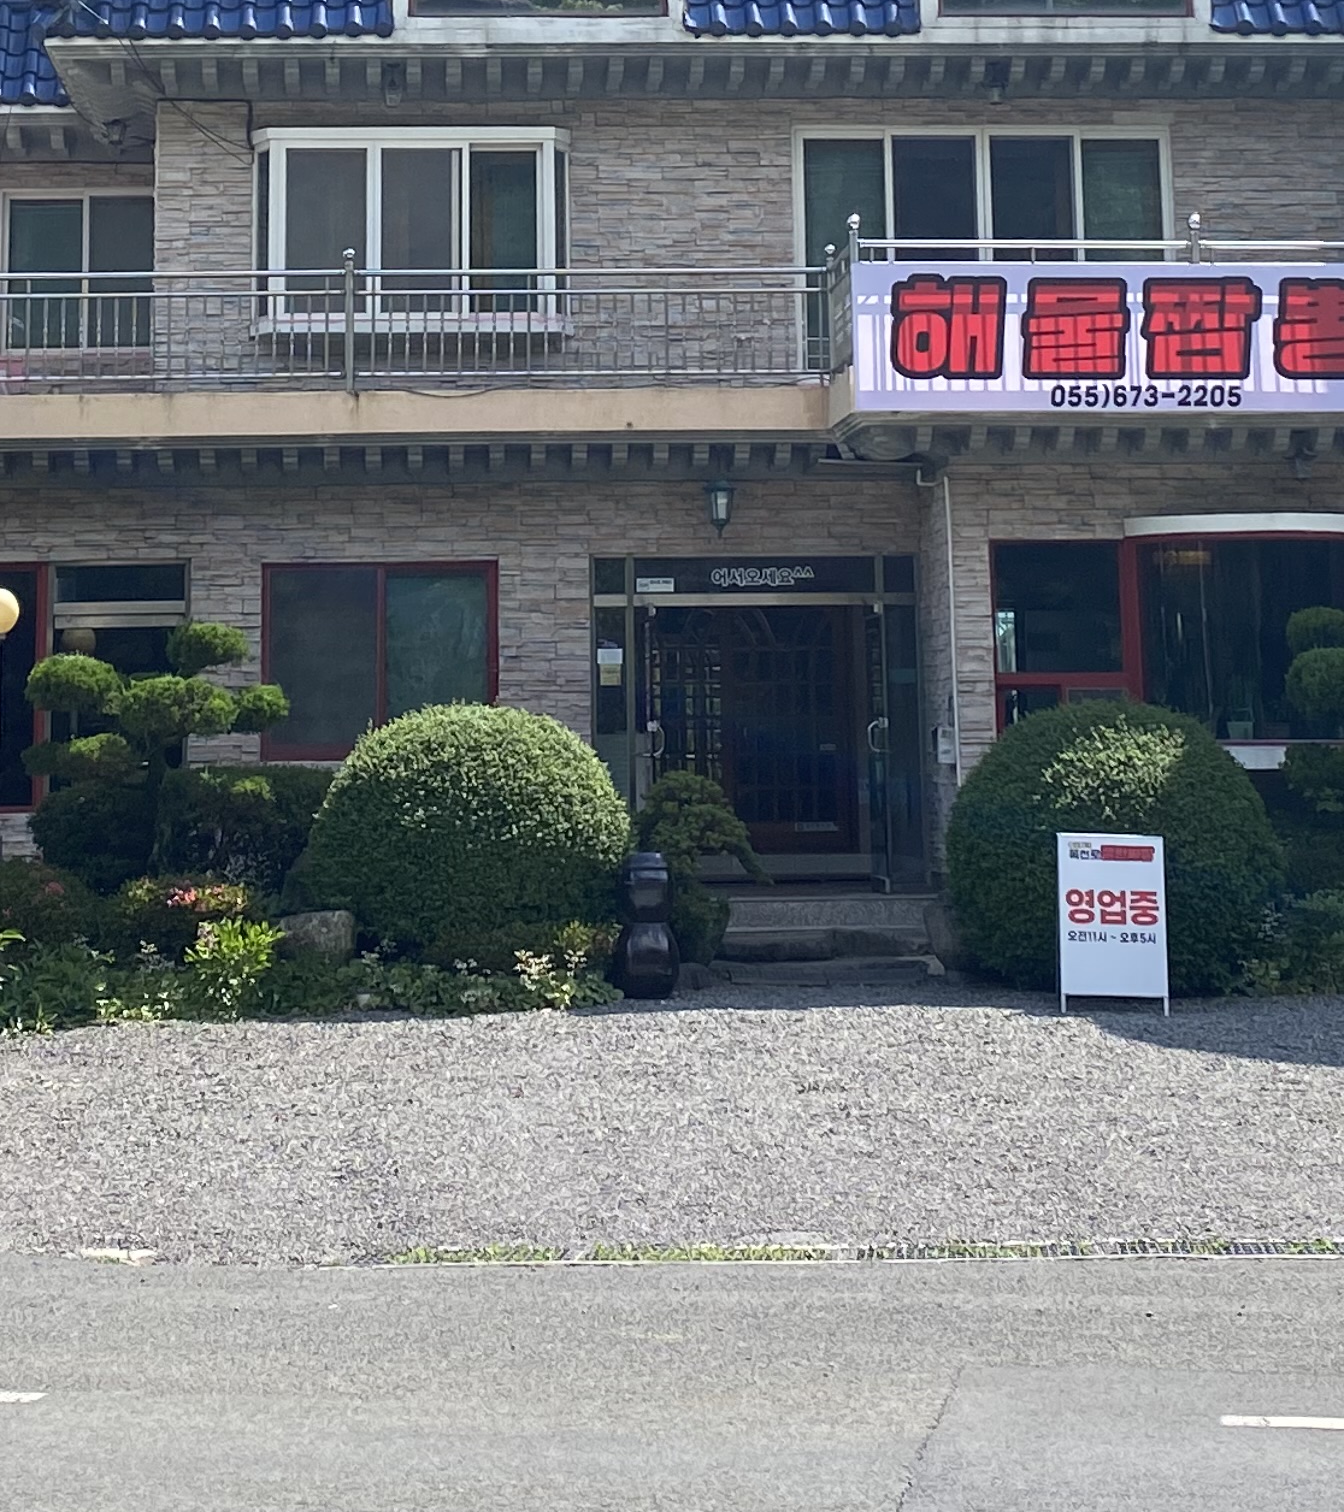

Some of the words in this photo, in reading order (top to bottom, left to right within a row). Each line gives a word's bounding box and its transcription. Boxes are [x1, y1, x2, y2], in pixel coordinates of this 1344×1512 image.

[1050, 384, 1242, 409] 055)673-2205
[1065, 888, 1160, 926] 영업중
[1067, 930, 1107, 943] 오전11시
[1119, 932, 1157, 944] 오후5시
